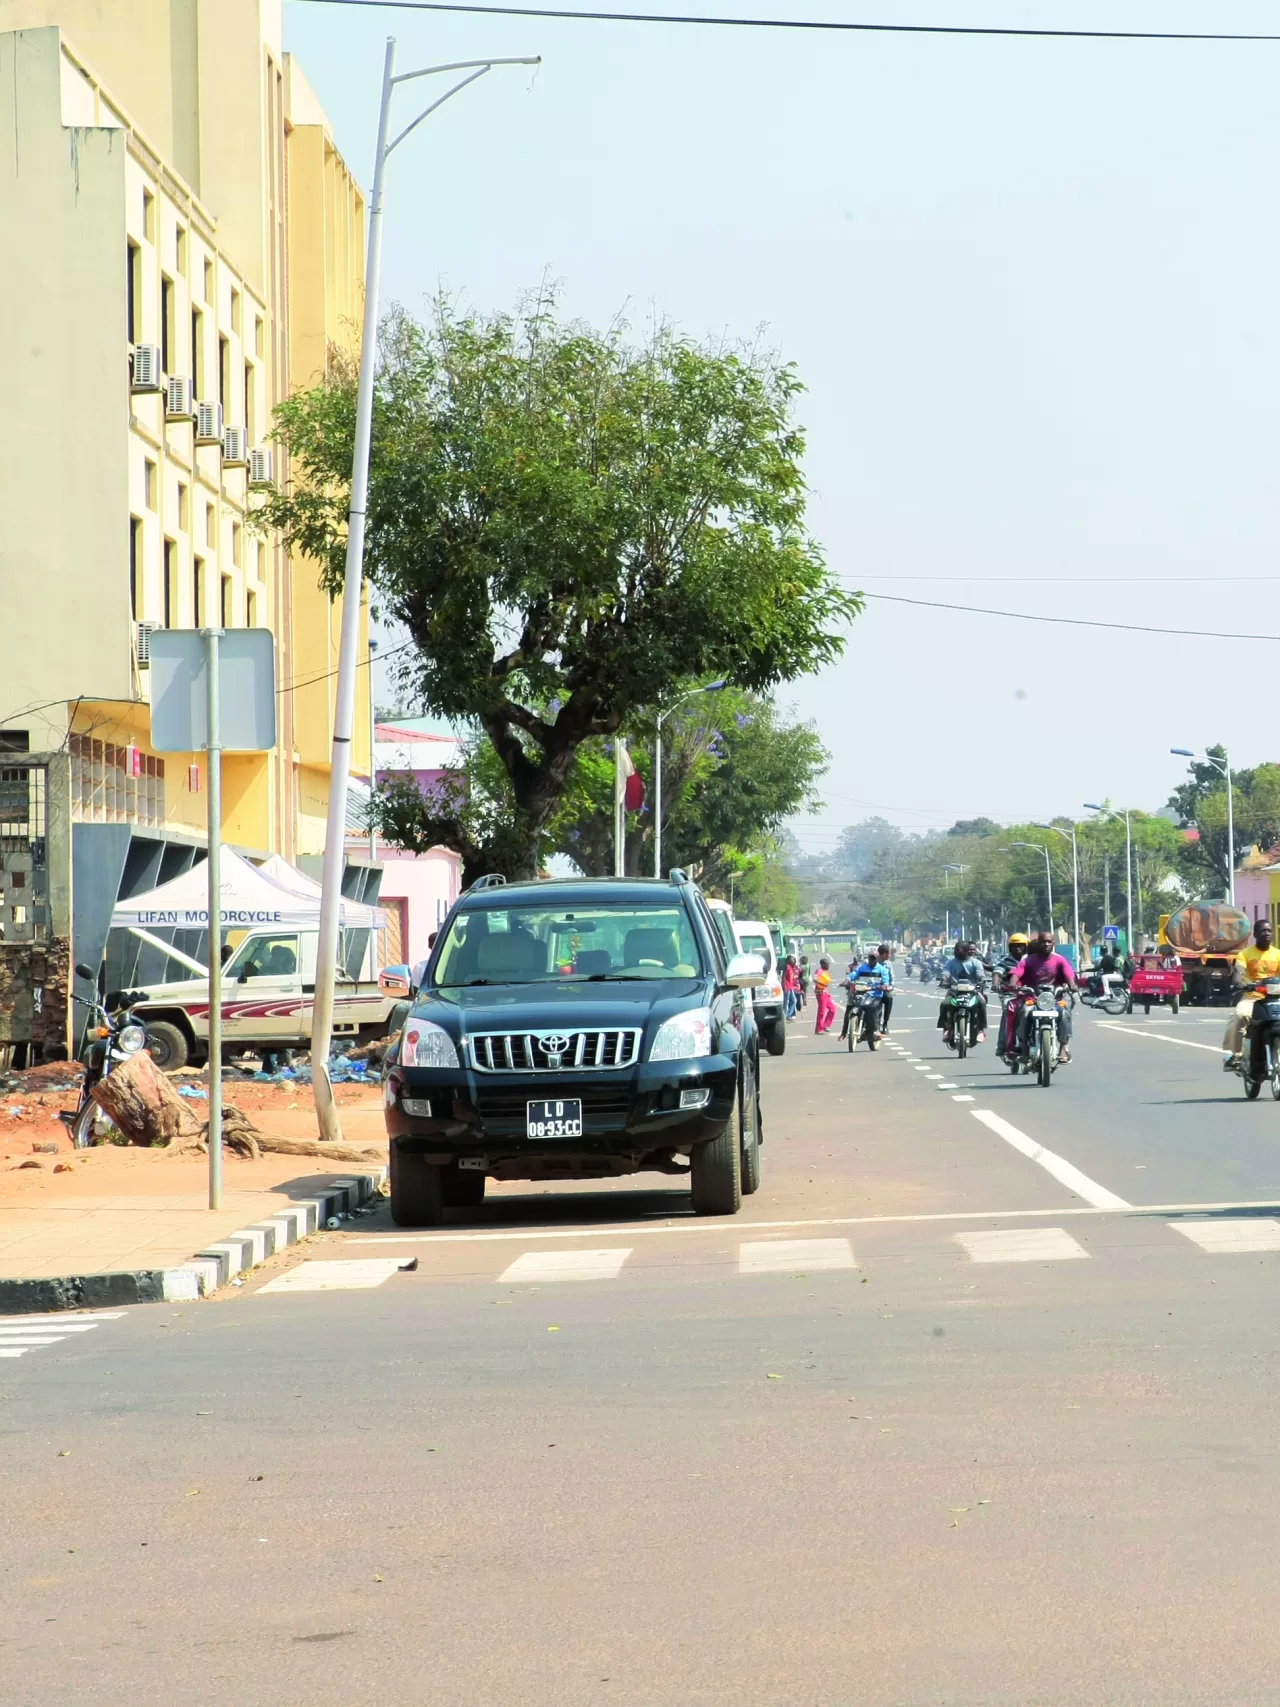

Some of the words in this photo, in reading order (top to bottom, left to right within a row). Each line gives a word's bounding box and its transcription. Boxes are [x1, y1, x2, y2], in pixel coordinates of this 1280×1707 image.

[137, 911, 178, 923] LIFAN
[185, 910, 282, 922] MOORCYCLE
[529, 1119, 580, 1137] 08-93-CC
